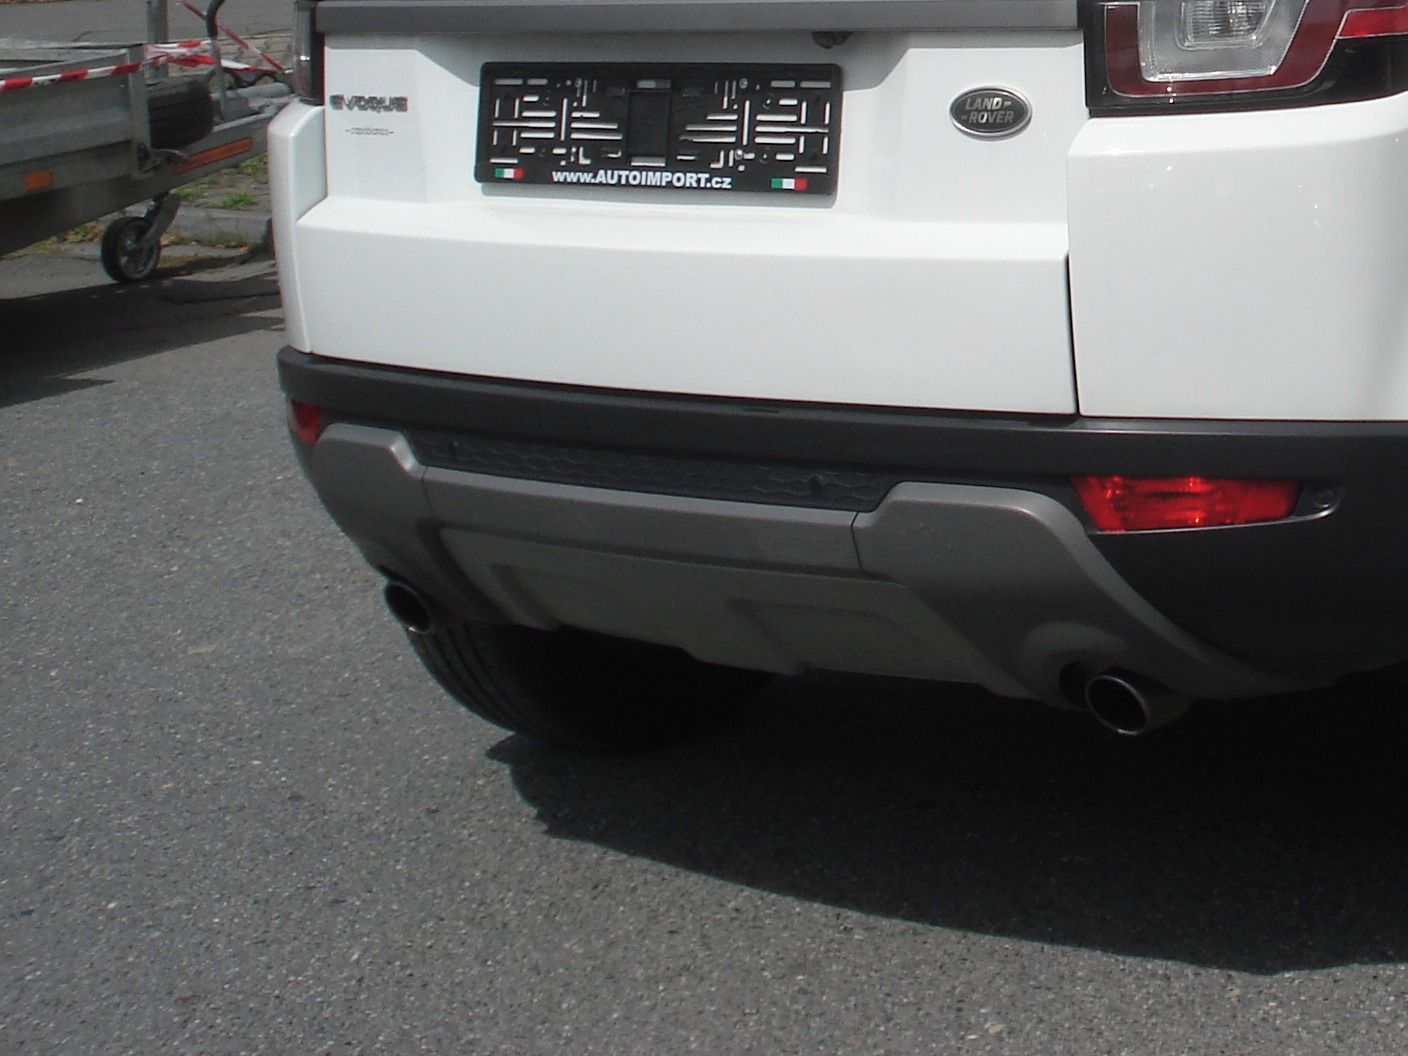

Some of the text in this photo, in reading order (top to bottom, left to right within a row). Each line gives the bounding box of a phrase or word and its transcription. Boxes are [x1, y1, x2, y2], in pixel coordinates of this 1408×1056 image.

[965, 97, 1003, 111] LAND
[968, 110, 1015, 124] ROVER
[551, 169, 732, 189] www.AUTOIMPORT.cz
